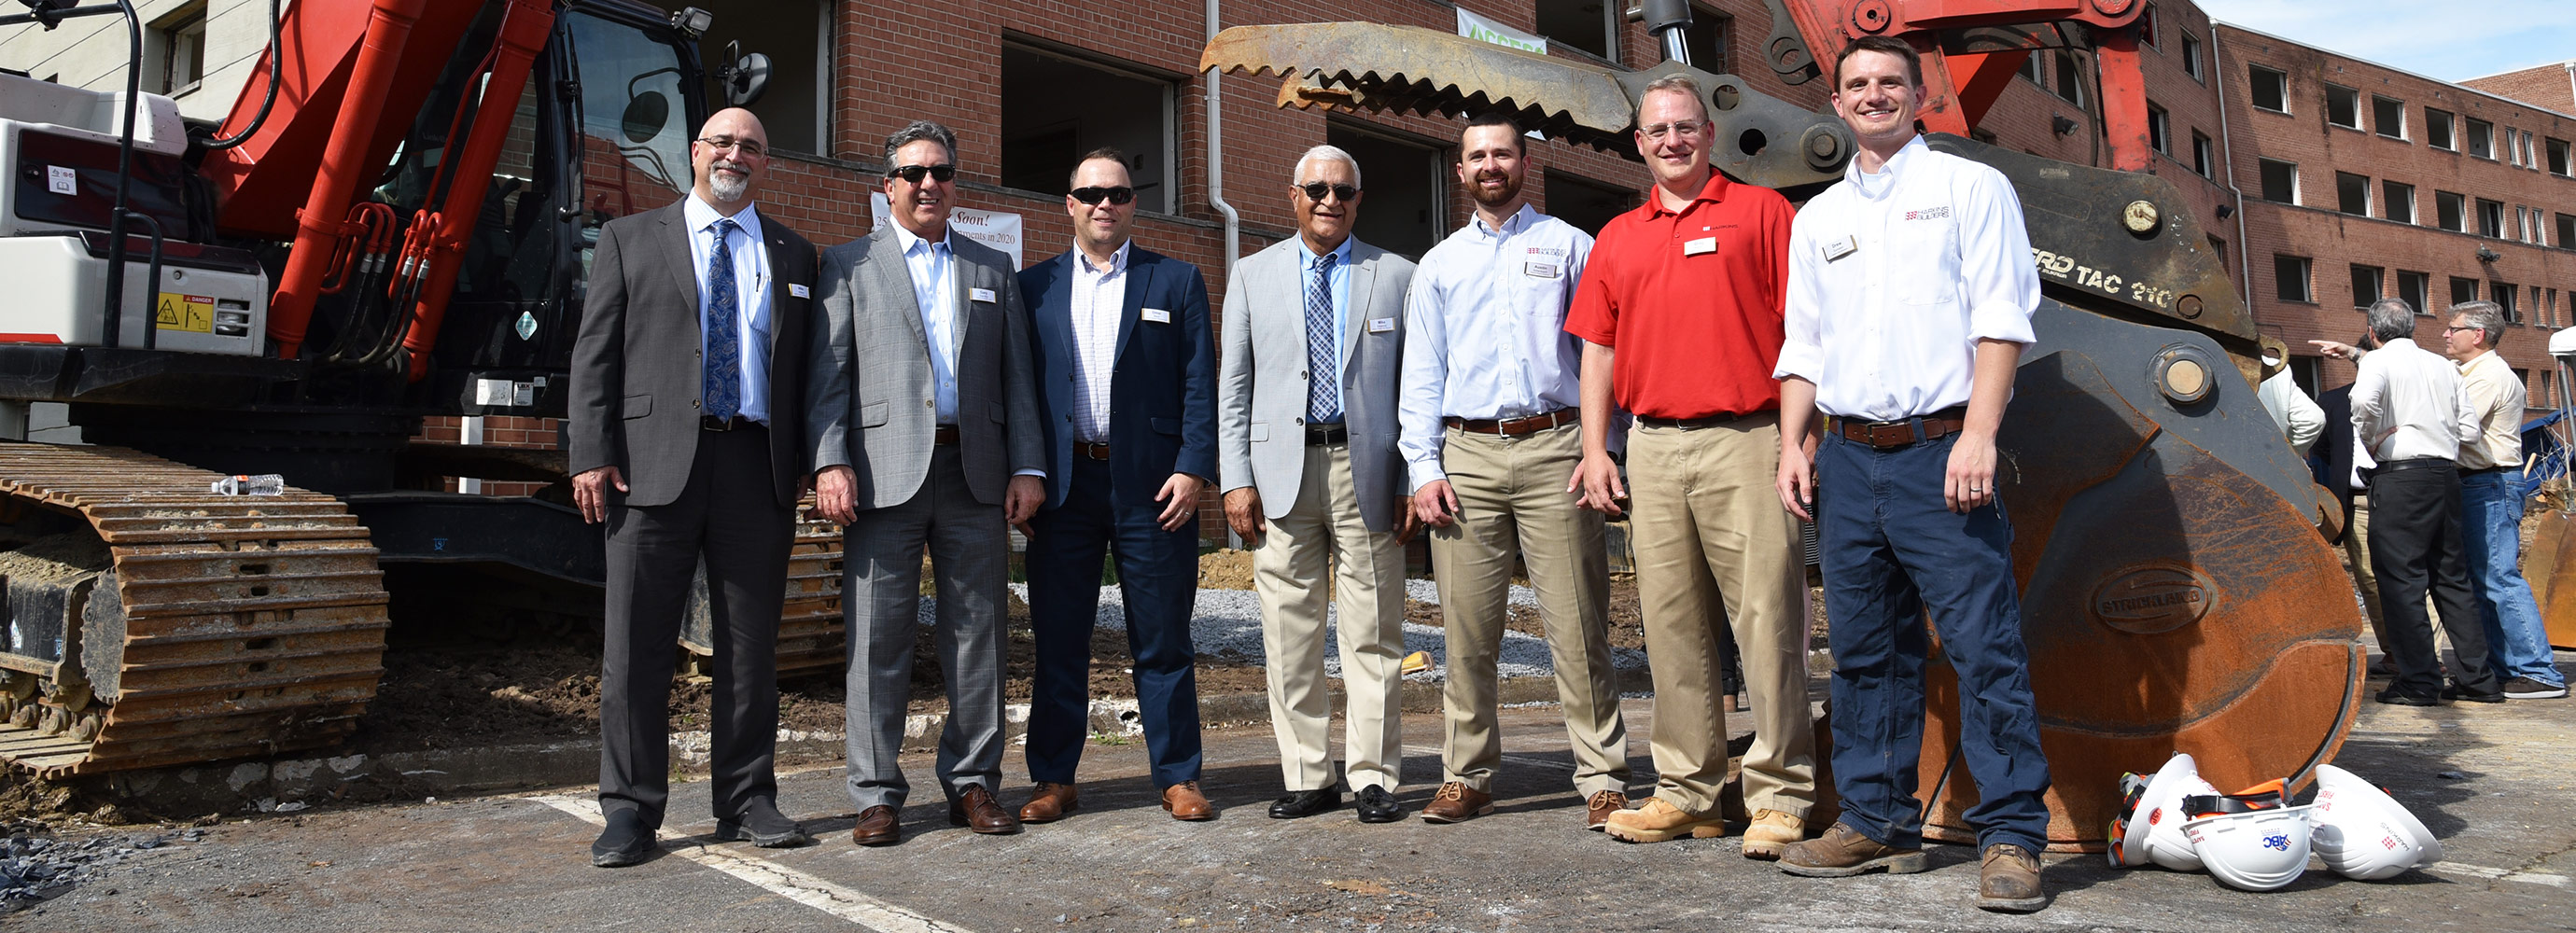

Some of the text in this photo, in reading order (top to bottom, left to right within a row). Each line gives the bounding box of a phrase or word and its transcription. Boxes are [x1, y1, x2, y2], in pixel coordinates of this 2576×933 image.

[1917, 206, 1949, 215] HARKINS
[1917, 213, 1949, 221] BUILDERS
[954, 211, 989, 227] Soon!
[987, 230, 995, 242] in
[996, 232, 1015, 244] 2020
[2077, 266, 2122, 294] TAC
[2102, 589, 2200, 614] STRICKLAND
[2262, 834, 2289, 849] ABC
